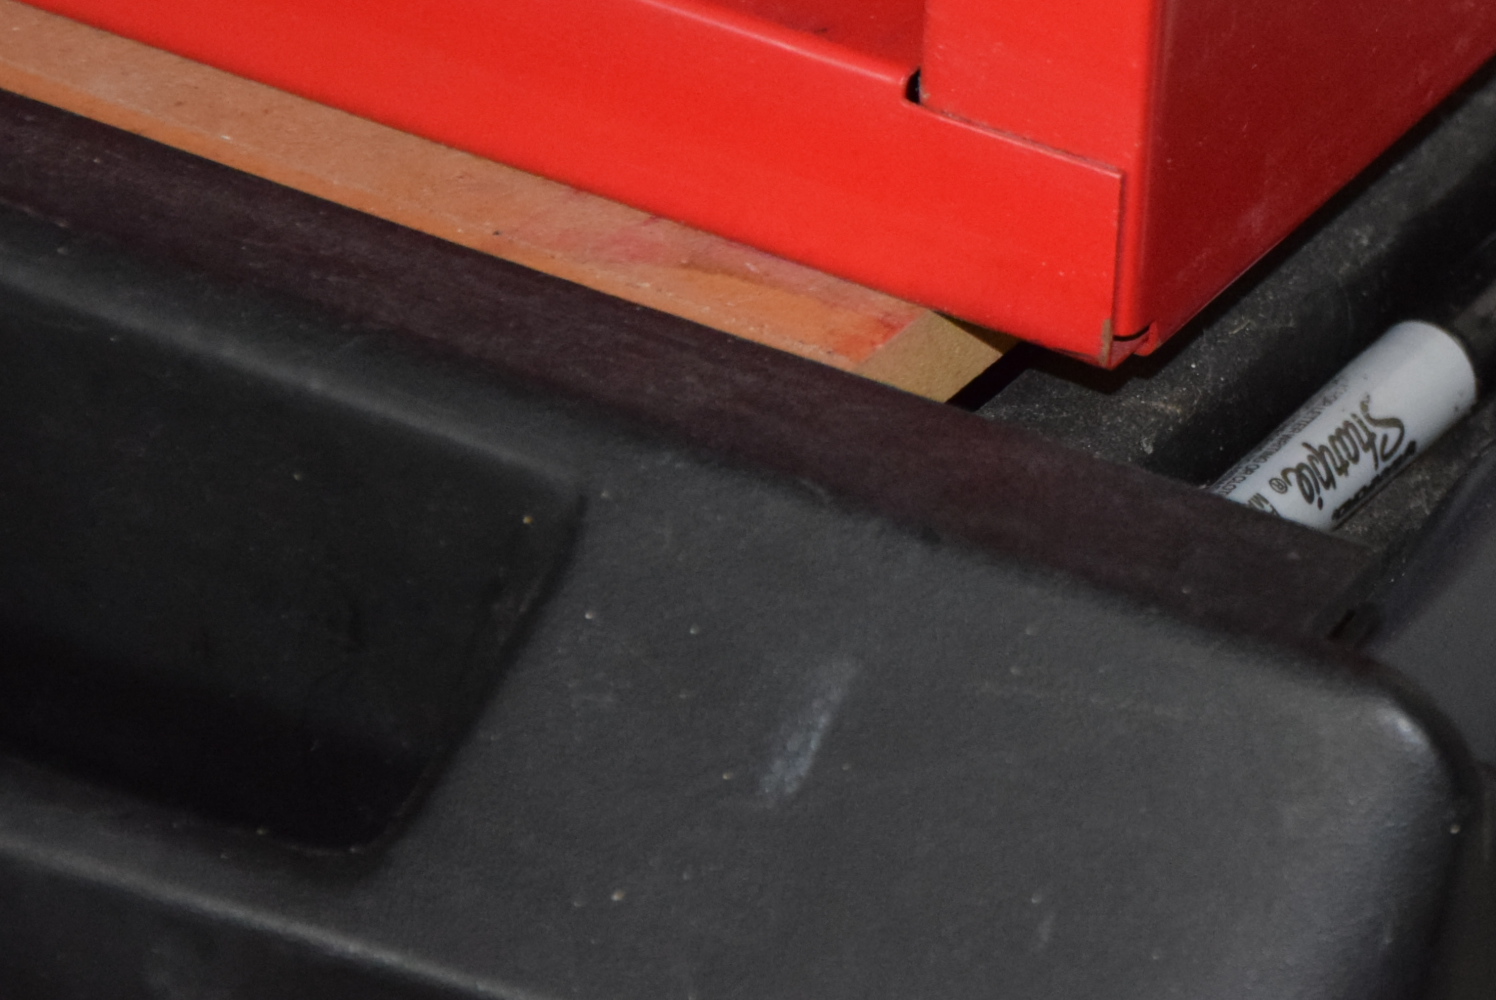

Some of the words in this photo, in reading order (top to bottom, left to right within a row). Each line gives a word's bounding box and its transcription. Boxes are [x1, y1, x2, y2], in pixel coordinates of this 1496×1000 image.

[1289, 406, 1326, 433] LETTER
[1281, 393, 1404, 510] Sharpie
[1217, 475, 1246, 496] CLOT
